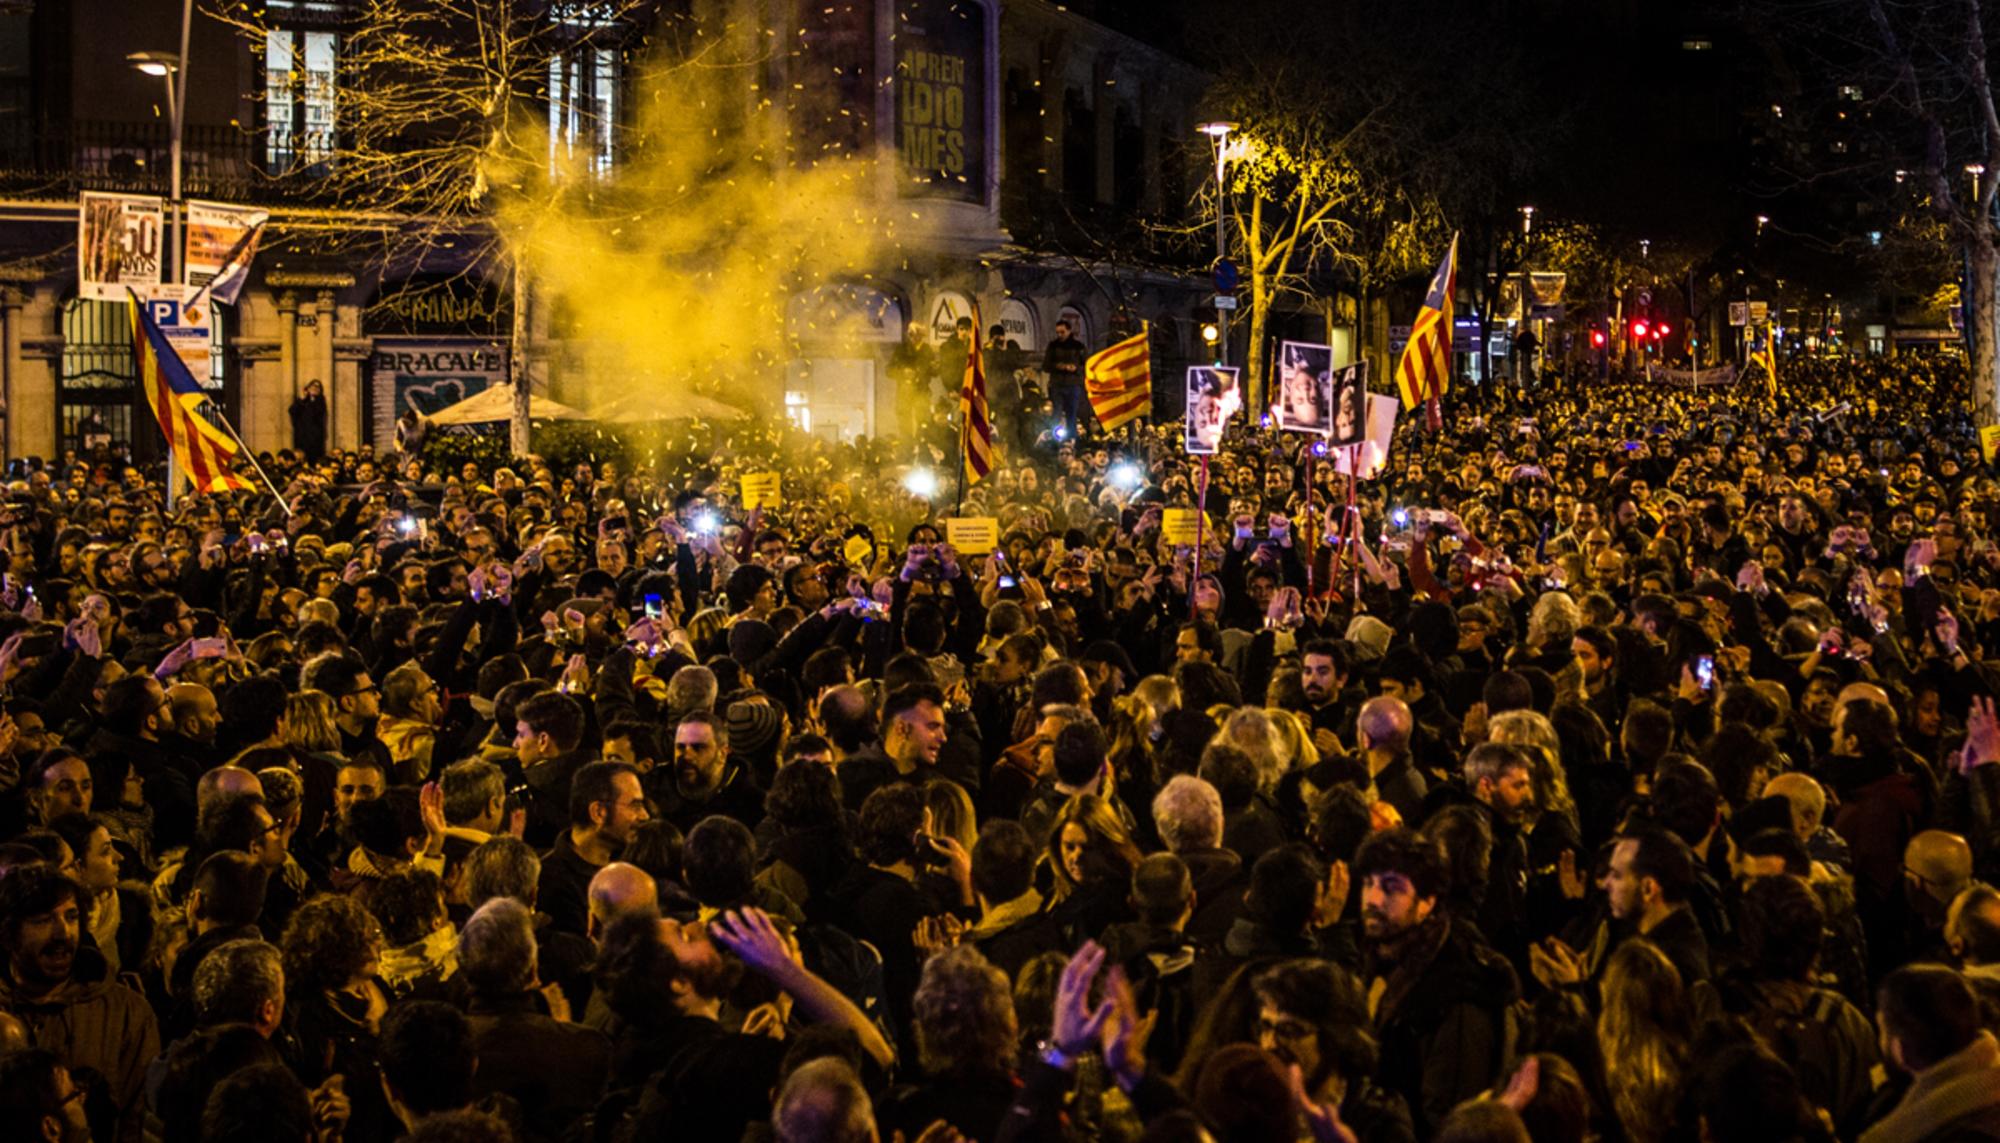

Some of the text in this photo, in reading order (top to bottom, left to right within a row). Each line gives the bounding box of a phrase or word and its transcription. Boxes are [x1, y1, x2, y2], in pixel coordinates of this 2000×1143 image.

[902, 49, 965, 84] APREN
[902, 125, 965, 174] MES
[119, 214, 158, 258] 50
[119, 254, 157, 273] ANYS
[155, 303, 172, 324] P
[399, 294, 485, 323] GRANJA
